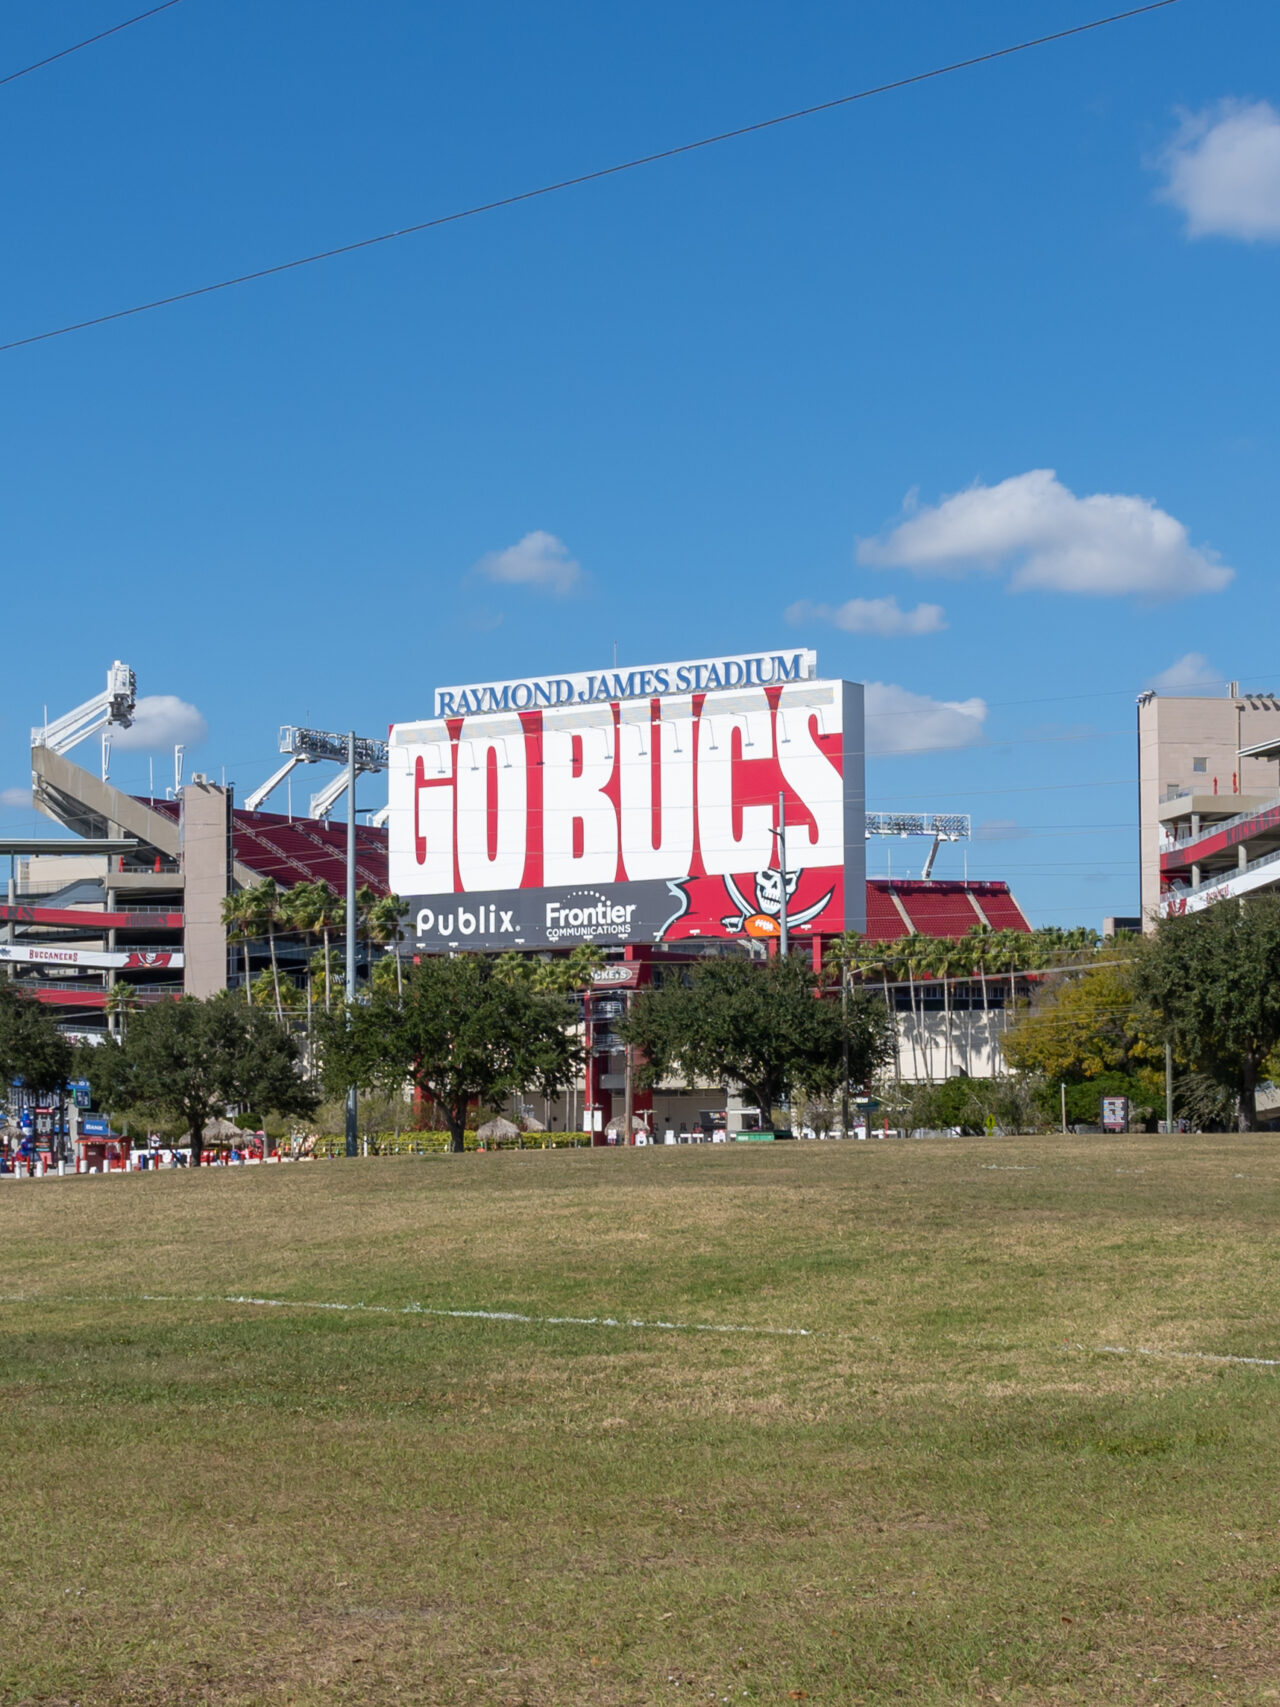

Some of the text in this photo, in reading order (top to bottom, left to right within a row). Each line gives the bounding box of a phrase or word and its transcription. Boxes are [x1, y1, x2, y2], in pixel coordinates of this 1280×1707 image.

[438, 654, 803, 717] RAYMOND JAMES STADIUM
[388, 681, 844, 897] GO BUCS
[416, 904, 514, 937] Publix
[546, 900, 637, 928] Frontier
[546, 924, 632, 937] COMMUNICATIONS
[29, 949, 78, 962] BUCCANEERS
